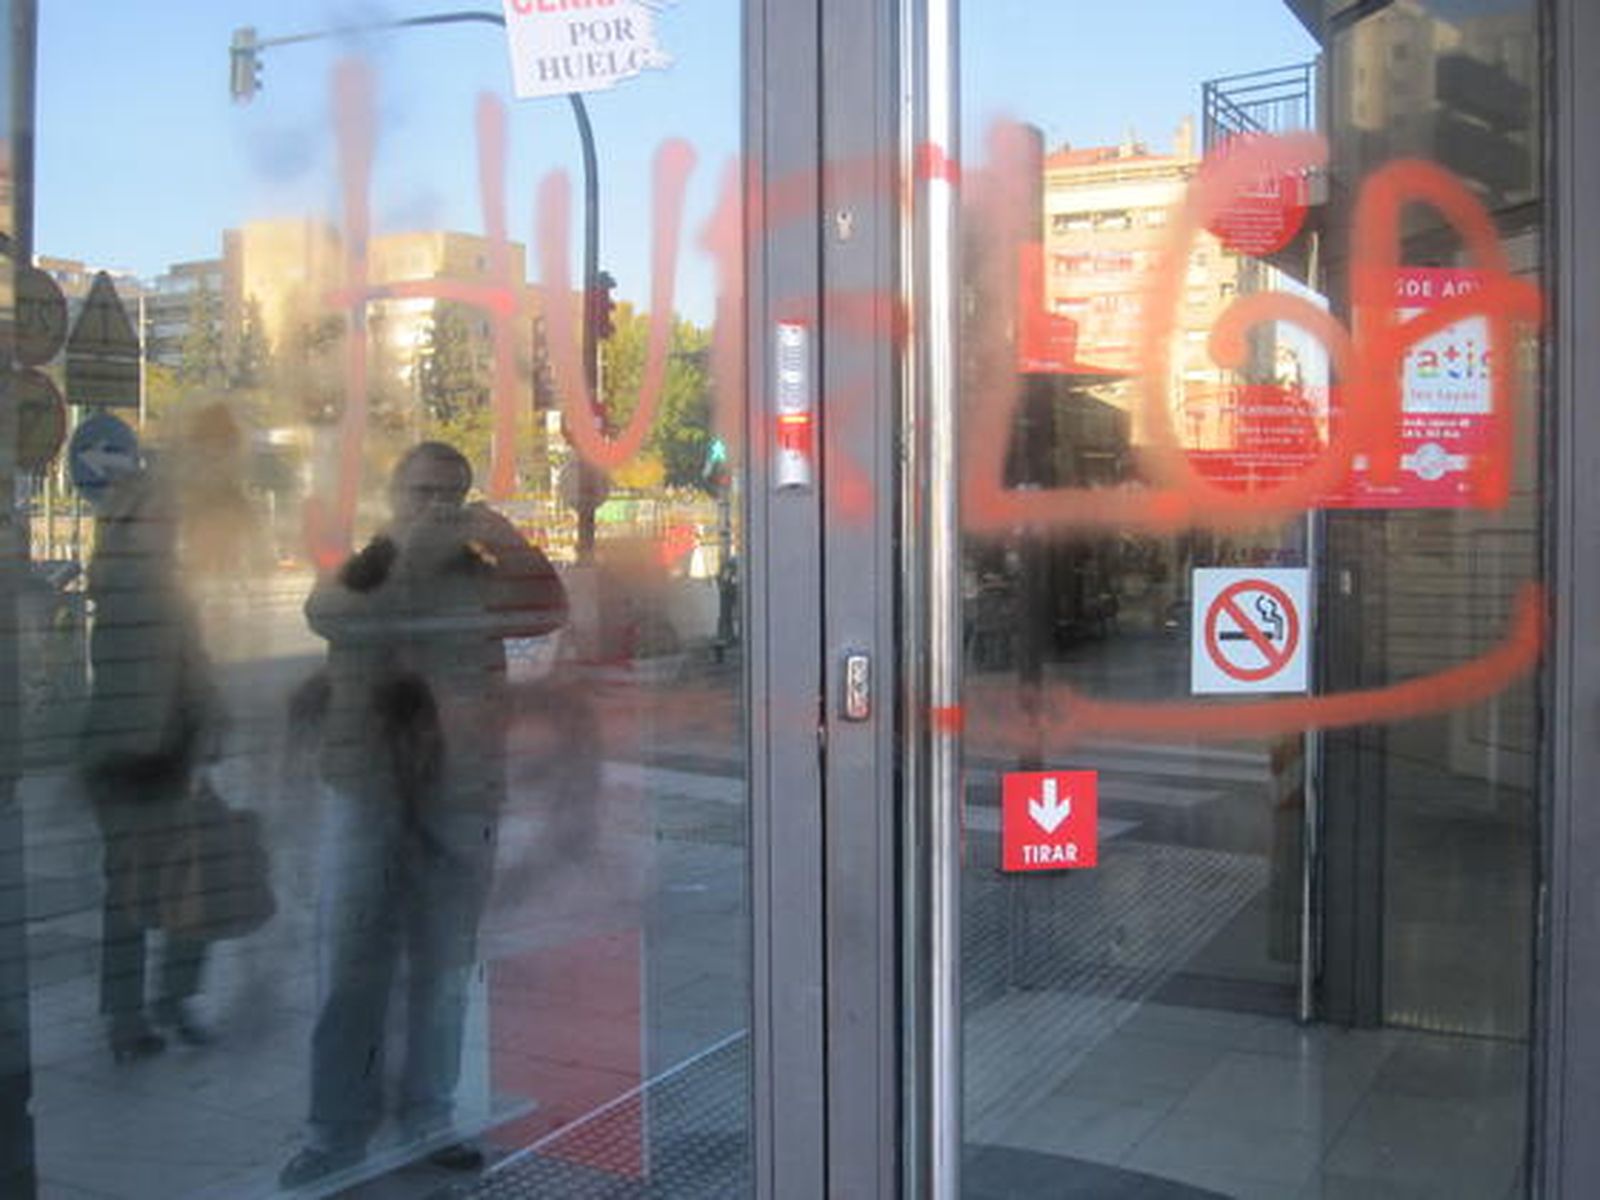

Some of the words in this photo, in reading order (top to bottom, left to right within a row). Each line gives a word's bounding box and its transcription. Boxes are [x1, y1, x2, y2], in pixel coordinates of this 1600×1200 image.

[569, 17, 635, 46] POR
[537, 49, 651, 82] HUELG
[304, 52, 1545, 572] HUELGA
[1023, 842, 1078, 865] TIRAR
